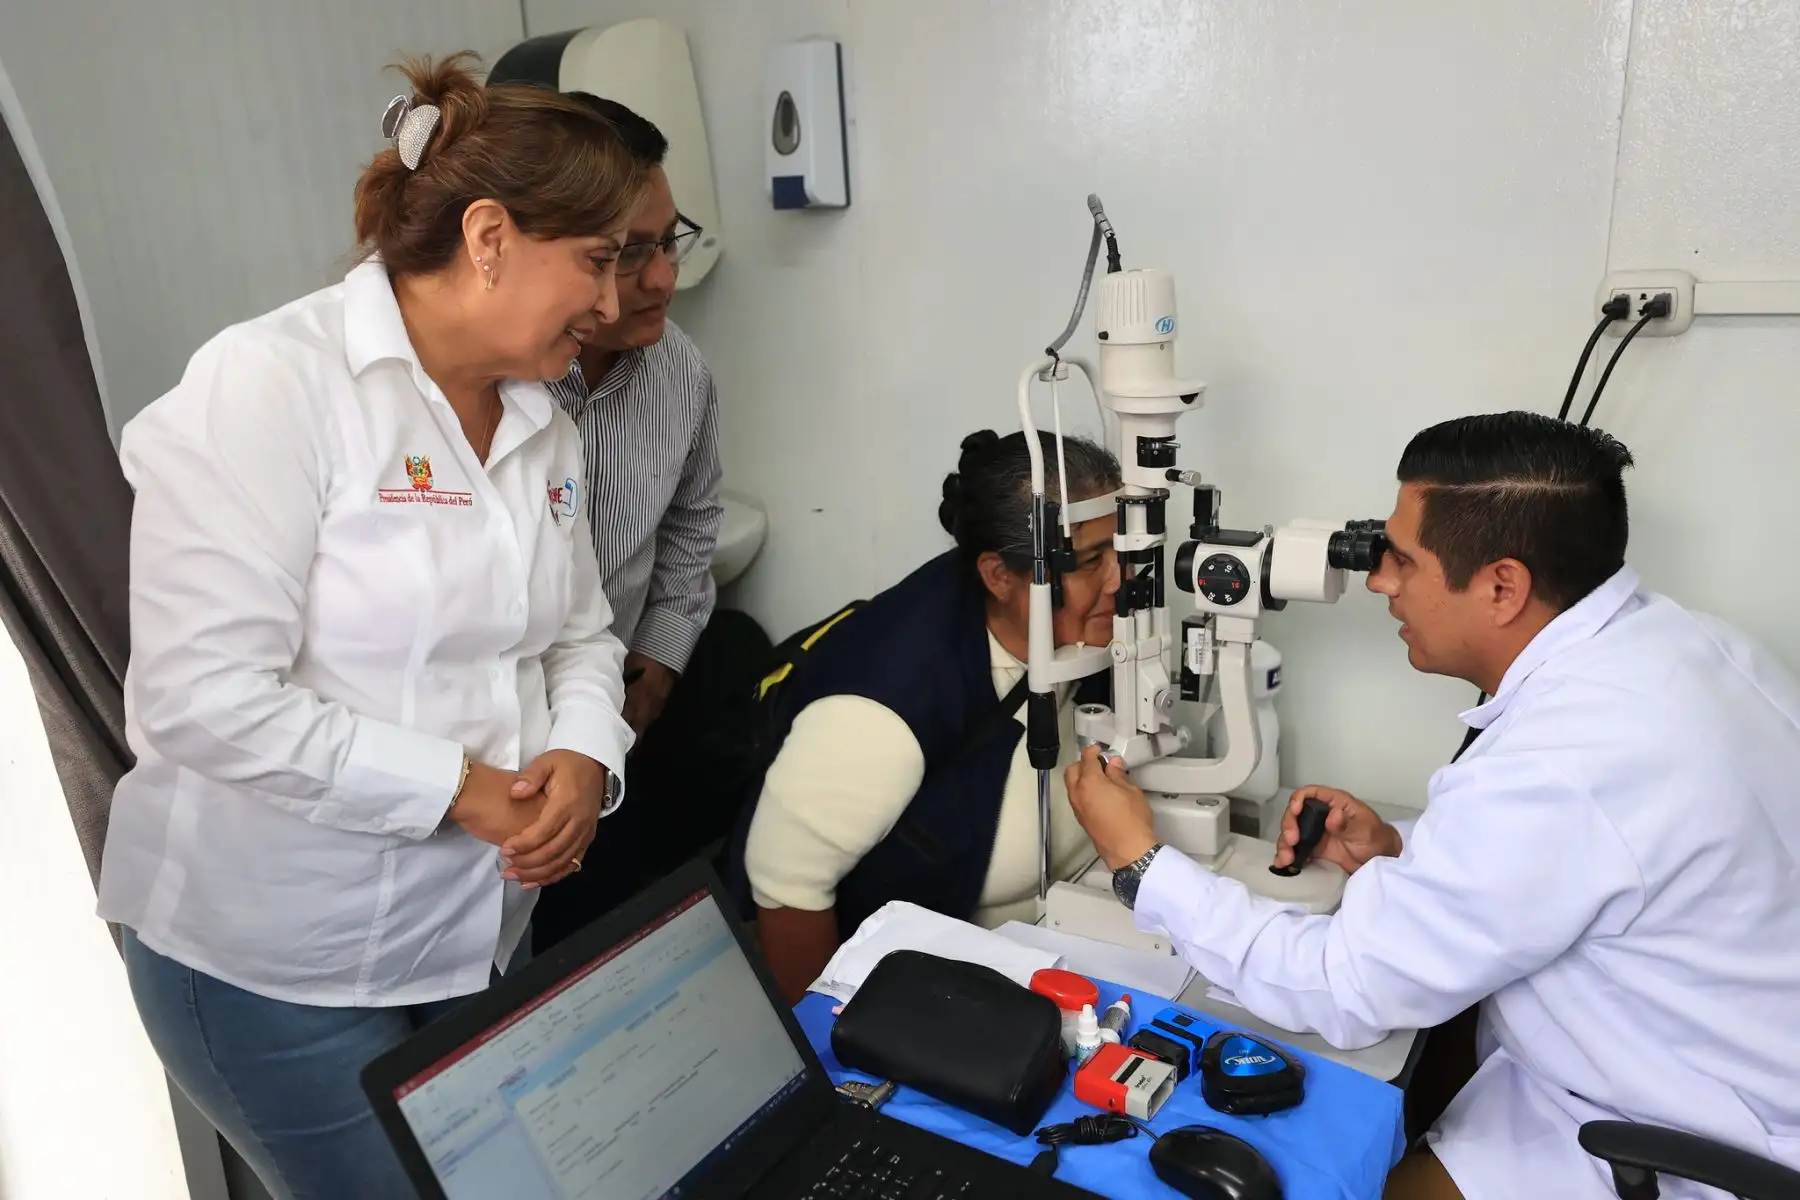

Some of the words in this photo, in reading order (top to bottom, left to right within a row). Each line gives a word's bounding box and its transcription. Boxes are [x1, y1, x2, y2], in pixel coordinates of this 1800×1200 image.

[379, 493, 407, 503] Presidencia
[407, 493, 415, 503] de
[421, 494, 448, 507] República
[448, 496, 458, 506] del
[458, 497, 473, 507] Perú
[1224, 564, 1233, 573] 10
[1224, 593, 1233, 603] 40
